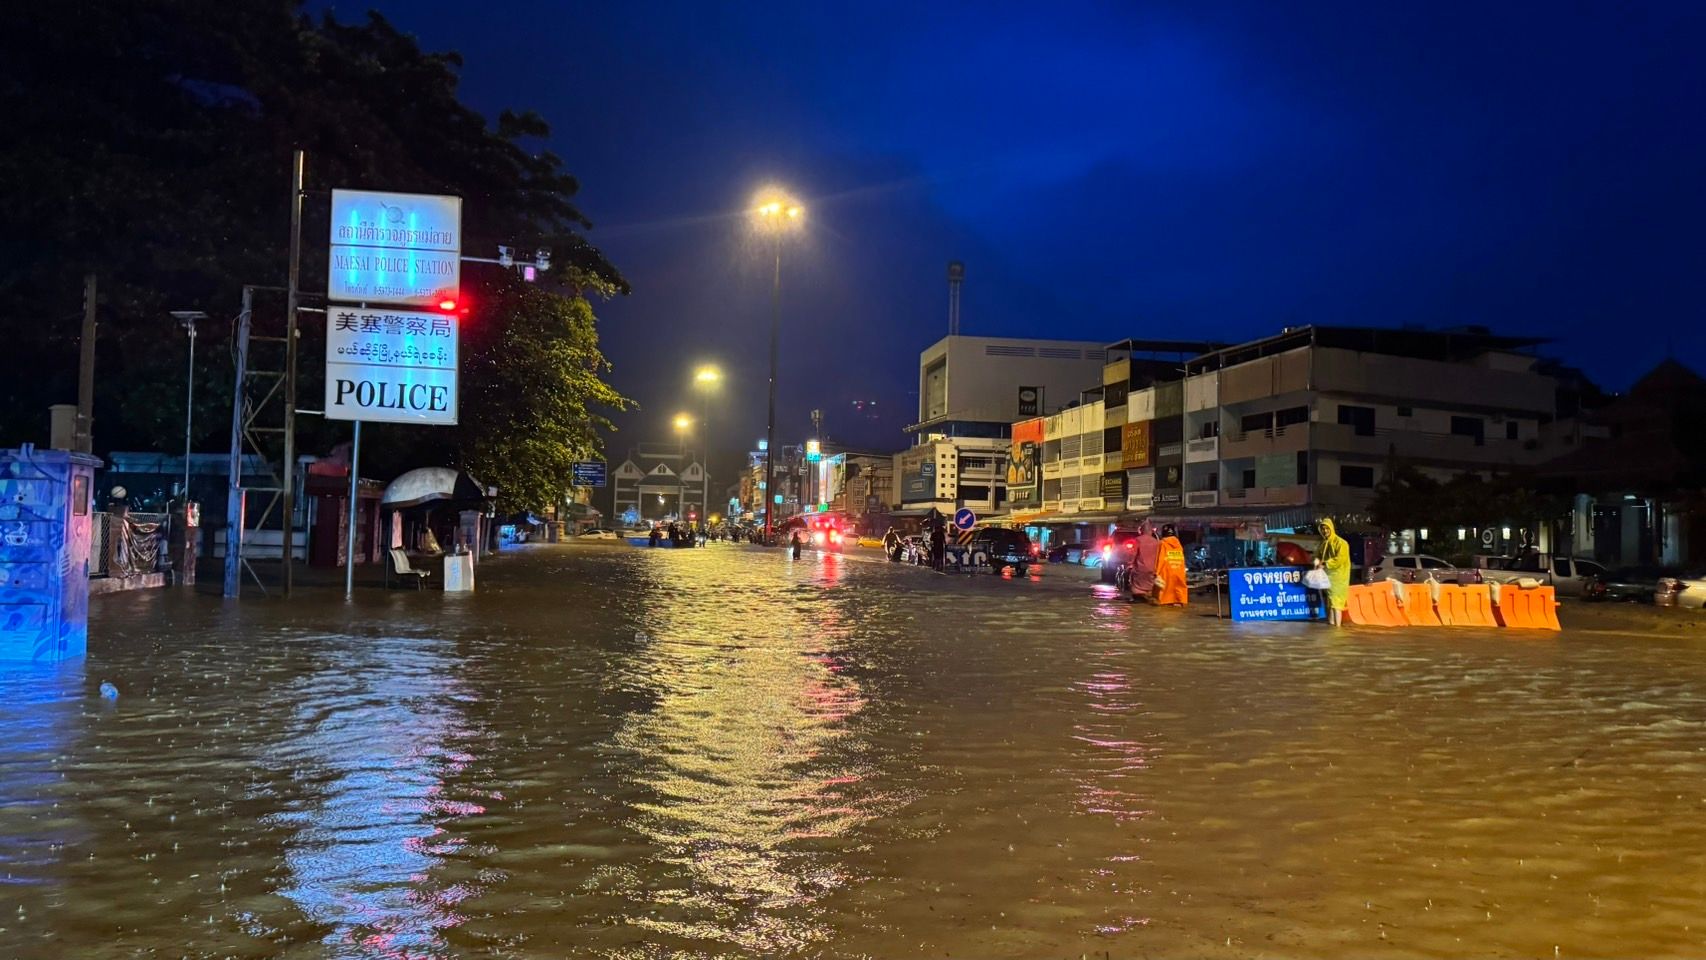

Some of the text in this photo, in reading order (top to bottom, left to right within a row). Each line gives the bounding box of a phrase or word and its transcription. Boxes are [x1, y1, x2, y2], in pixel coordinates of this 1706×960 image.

[334, 254, 455, 275] MAESAI POLICE STATION
[335, 312, 451, 338] 美塞警察局
[334, 379, 448, 412] POLICE
[1243, 571, 1301, 592] จุดหยุดร
